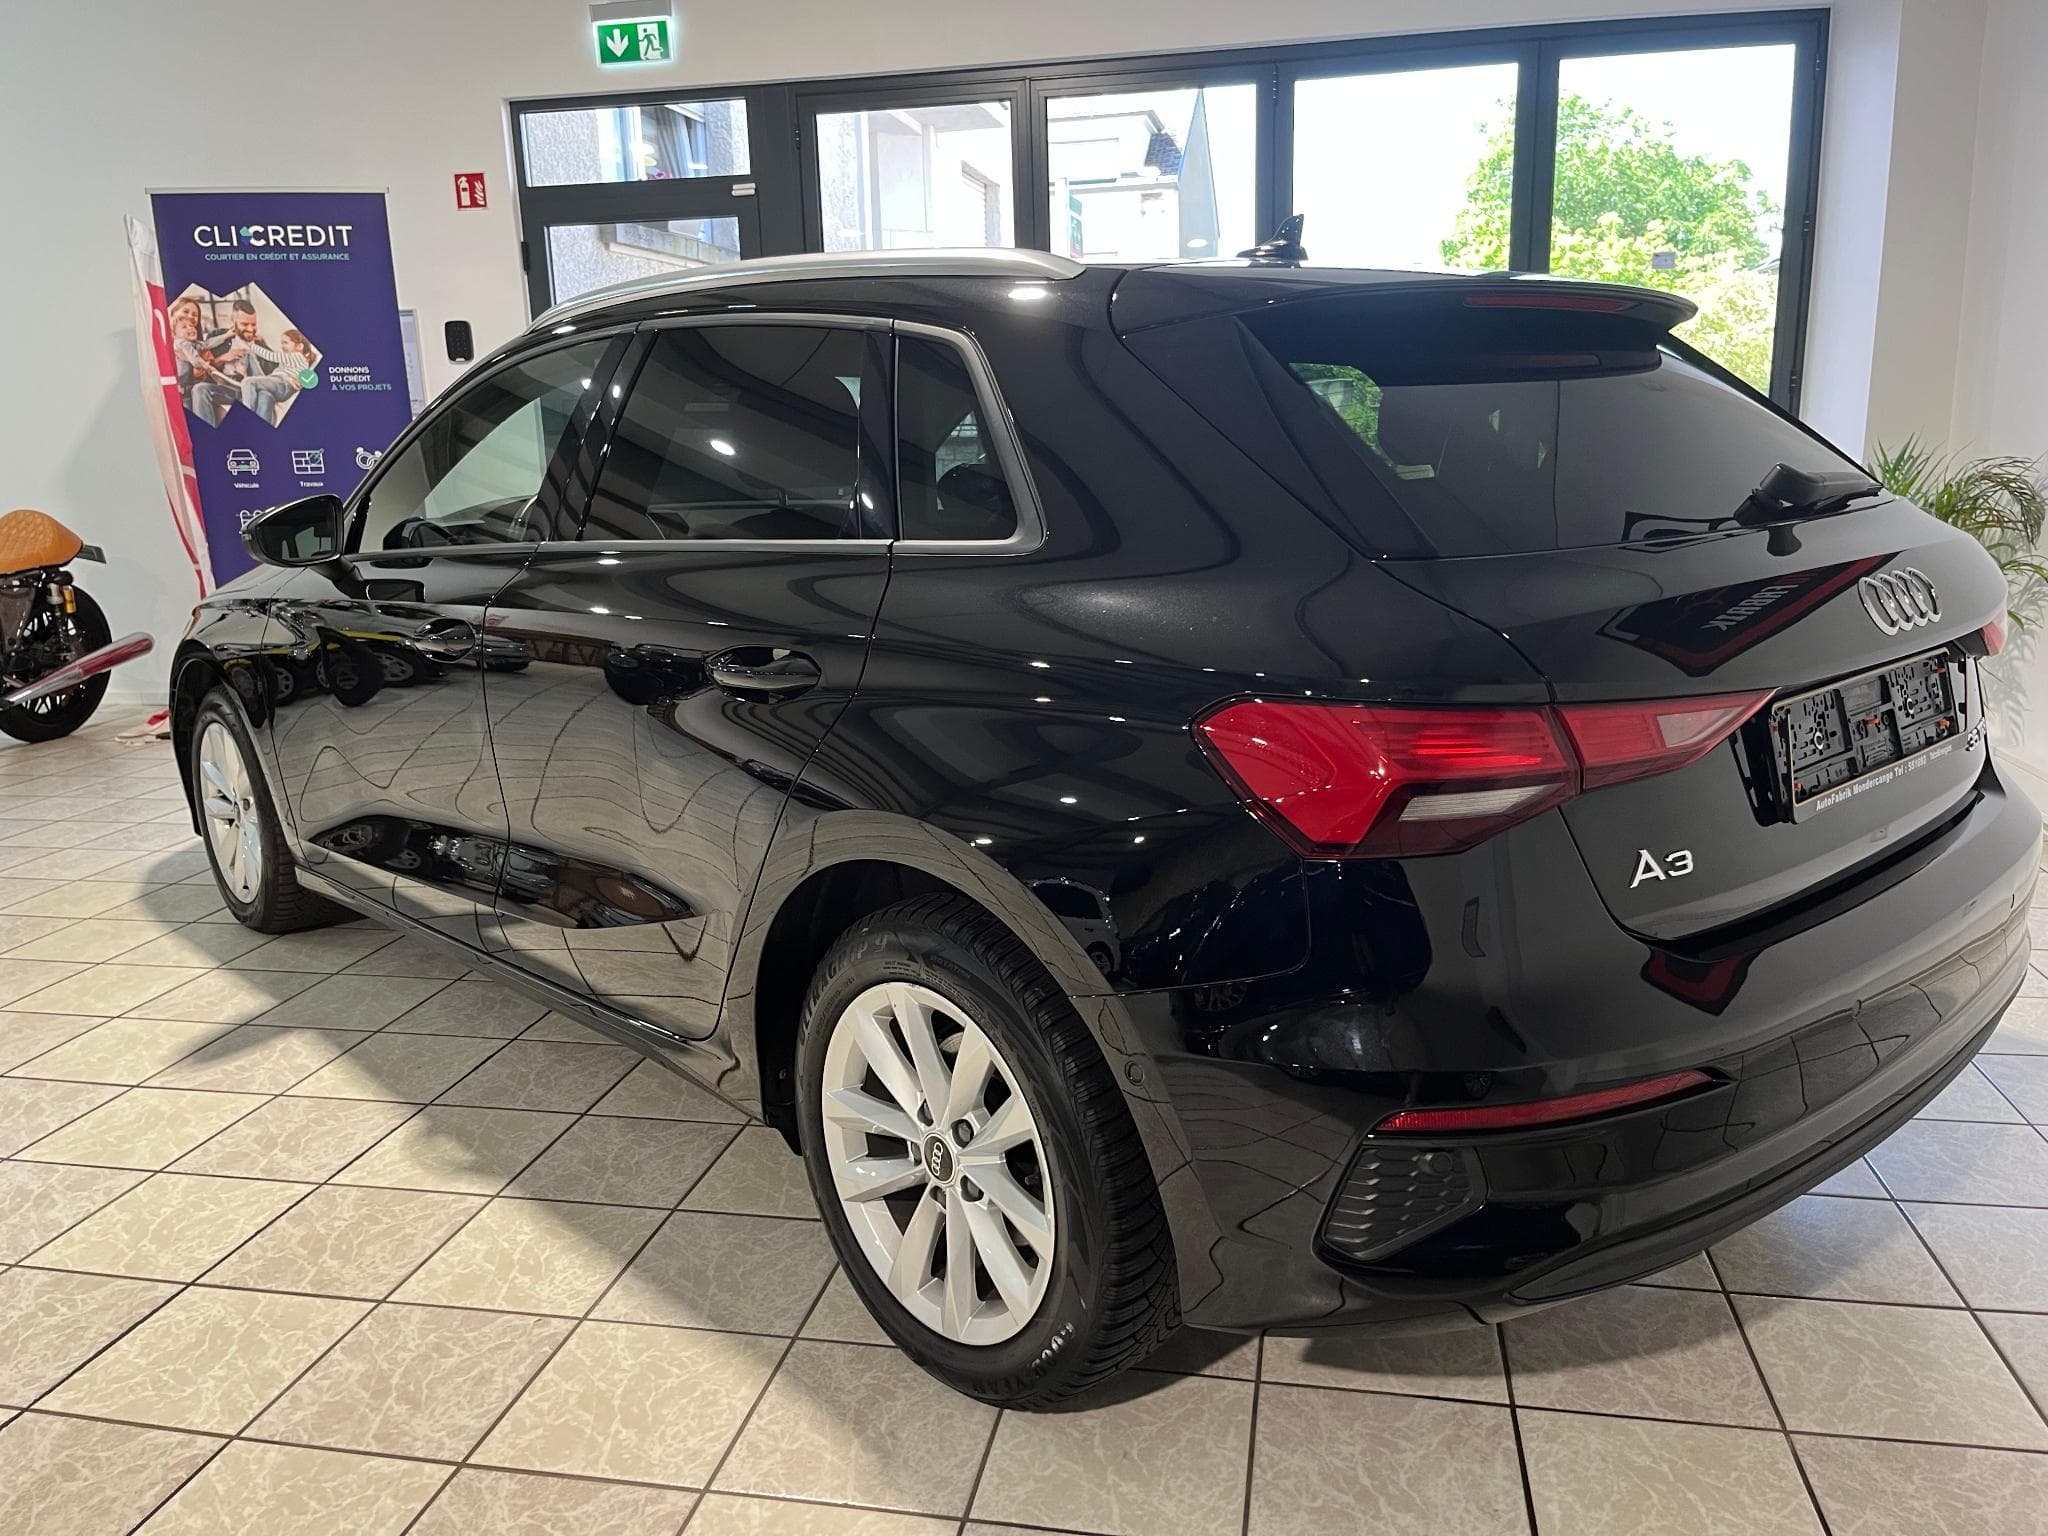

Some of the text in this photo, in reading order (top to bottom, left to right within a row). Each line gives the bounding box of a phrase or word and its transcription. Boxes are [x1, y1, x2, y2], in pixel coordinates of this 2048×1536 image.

[205, 253, 244, 261] COURTIER
[246, 253, 258, 261] EN
[289, 253, 299, 261] ET
[301, 253, 350, 261] ASSURANCE
[328, 366, 370, 374] DONNONS
[330, 375, 342, 383] DU
[357, 383, 392, 391] PROJETS
[1629, 849, 1694, 889] A3
